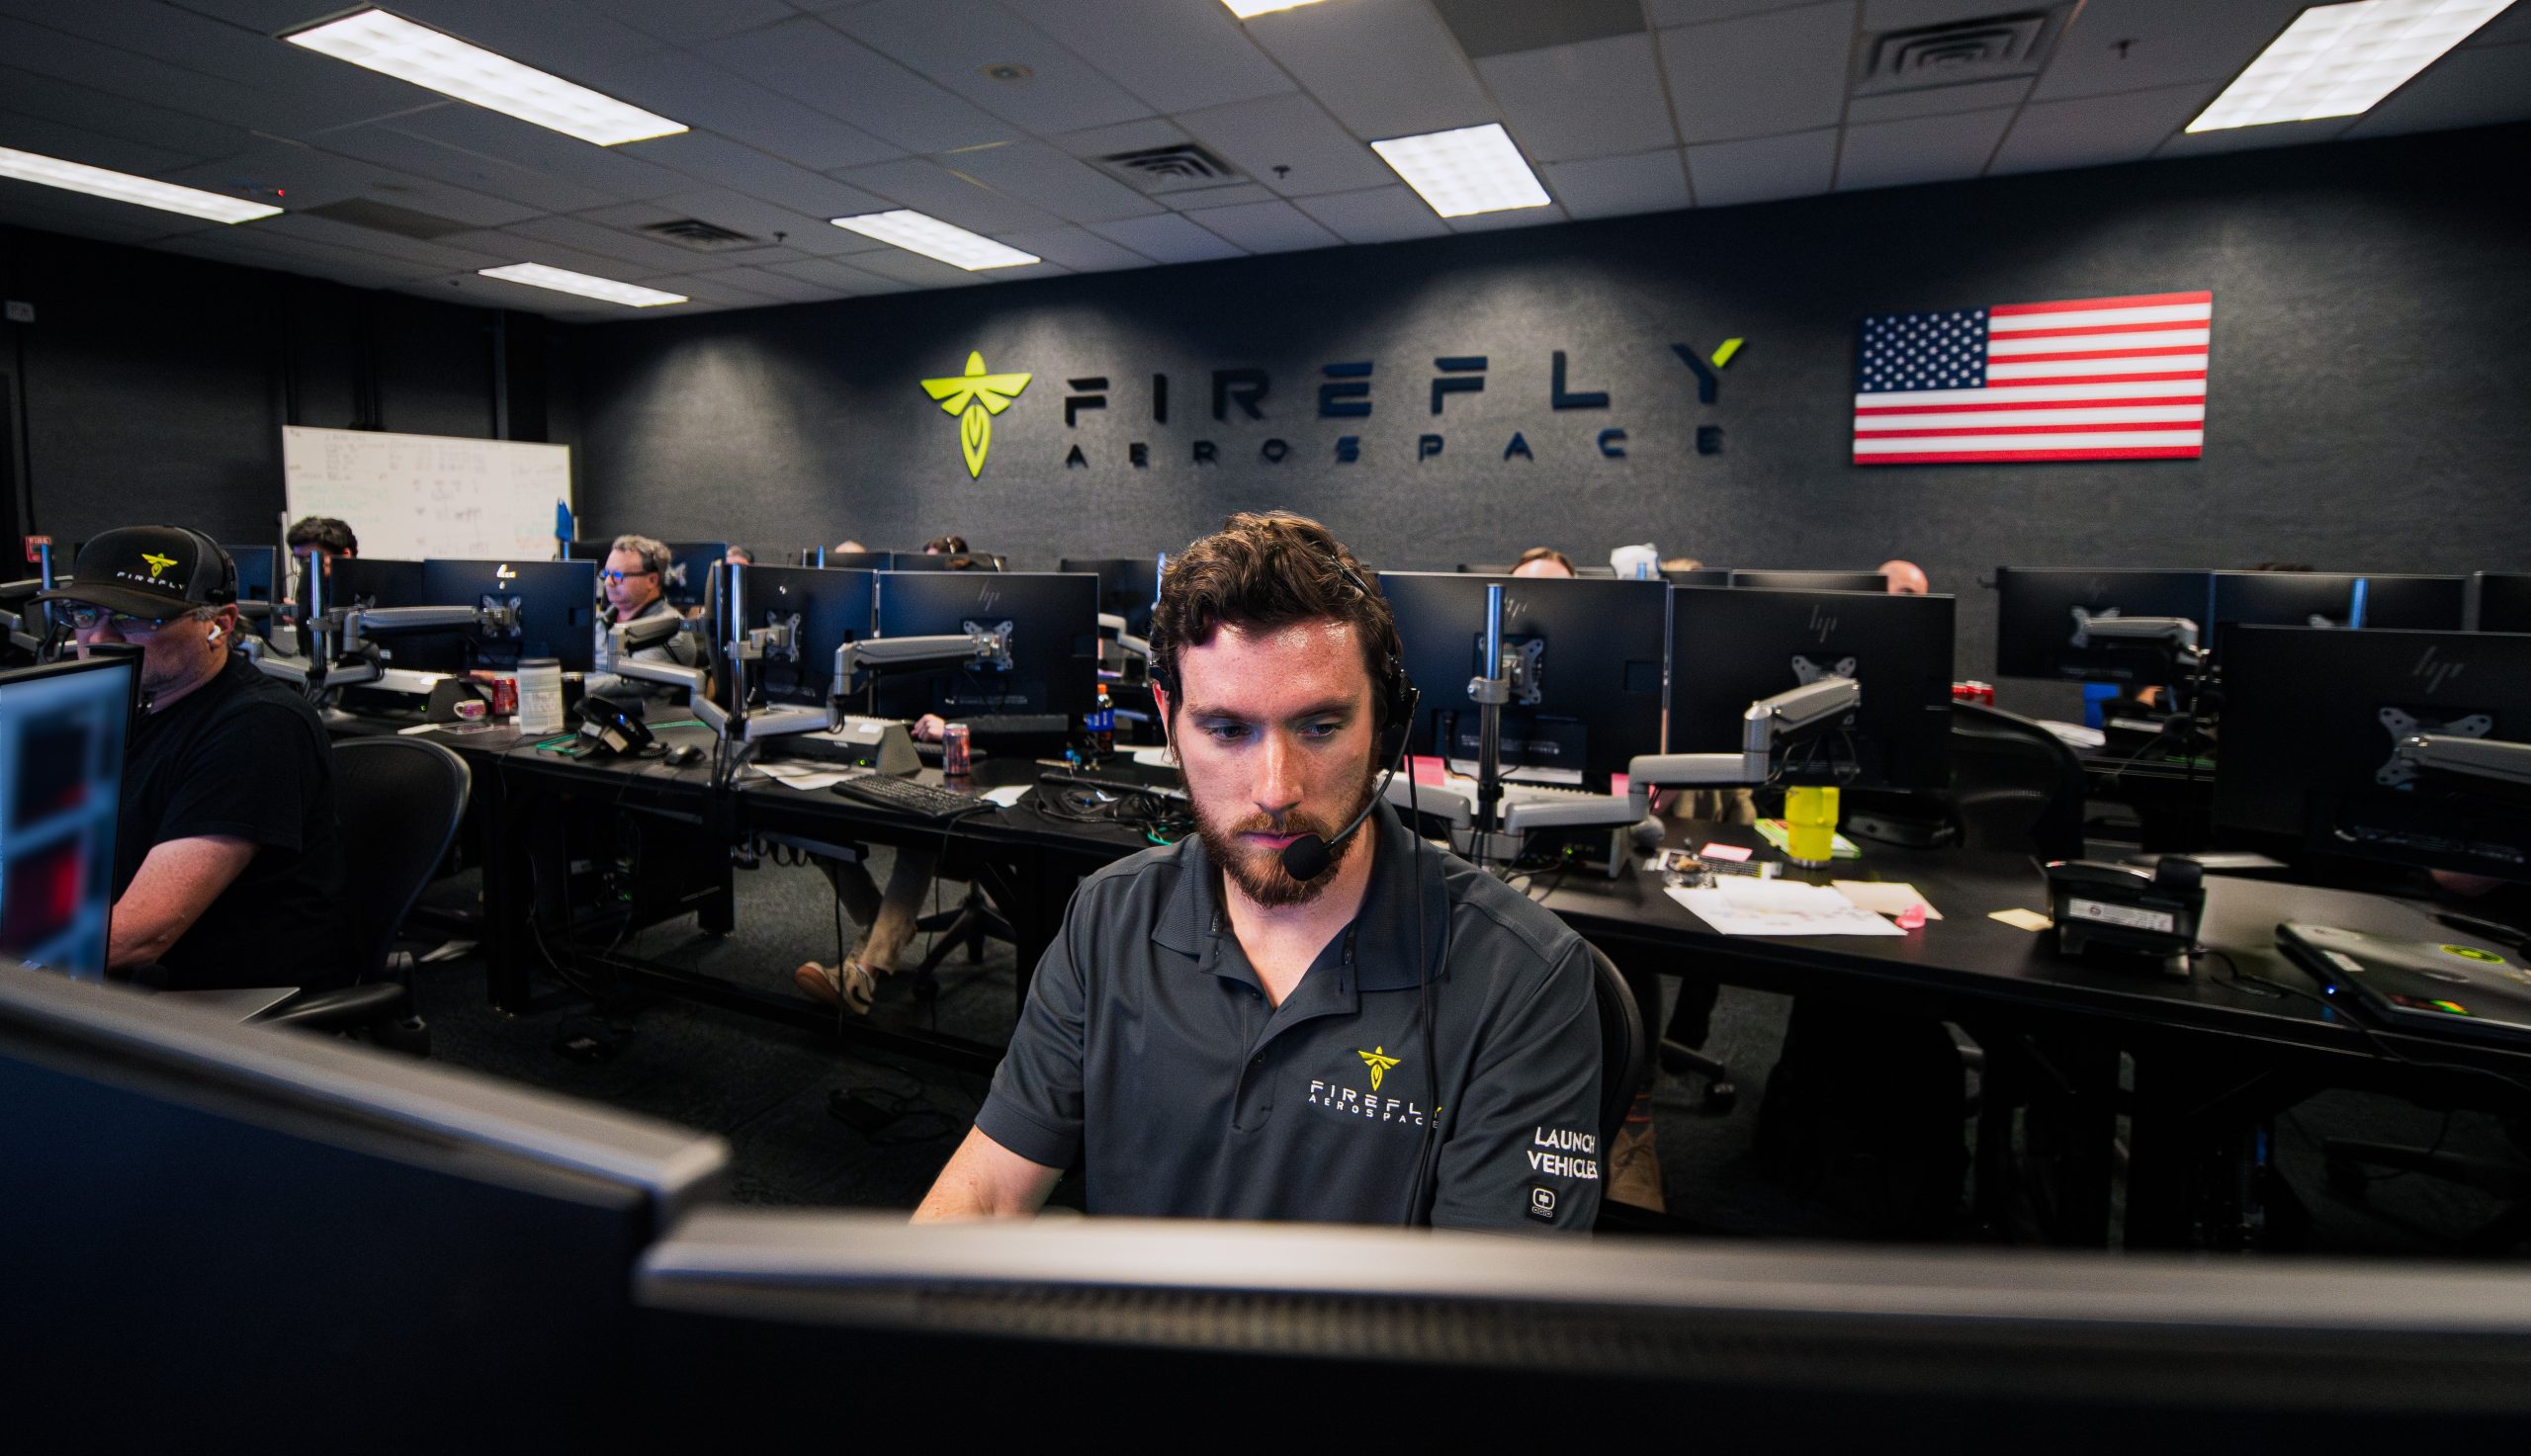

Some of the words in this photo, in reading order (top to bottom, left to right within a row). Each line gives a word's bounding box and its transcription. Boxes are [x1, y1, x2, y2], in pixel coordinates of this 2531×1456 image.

[1065, 337, 1745, 427] FIREFLY
[1065, 425, 1725, 470] AEROSPACE
[117, 571, 186, 590] FIREFLY
[1534, 1126, 1596, 1155] LAUNCH
[1527, 1150, 1599, 1179] VEHICLES
